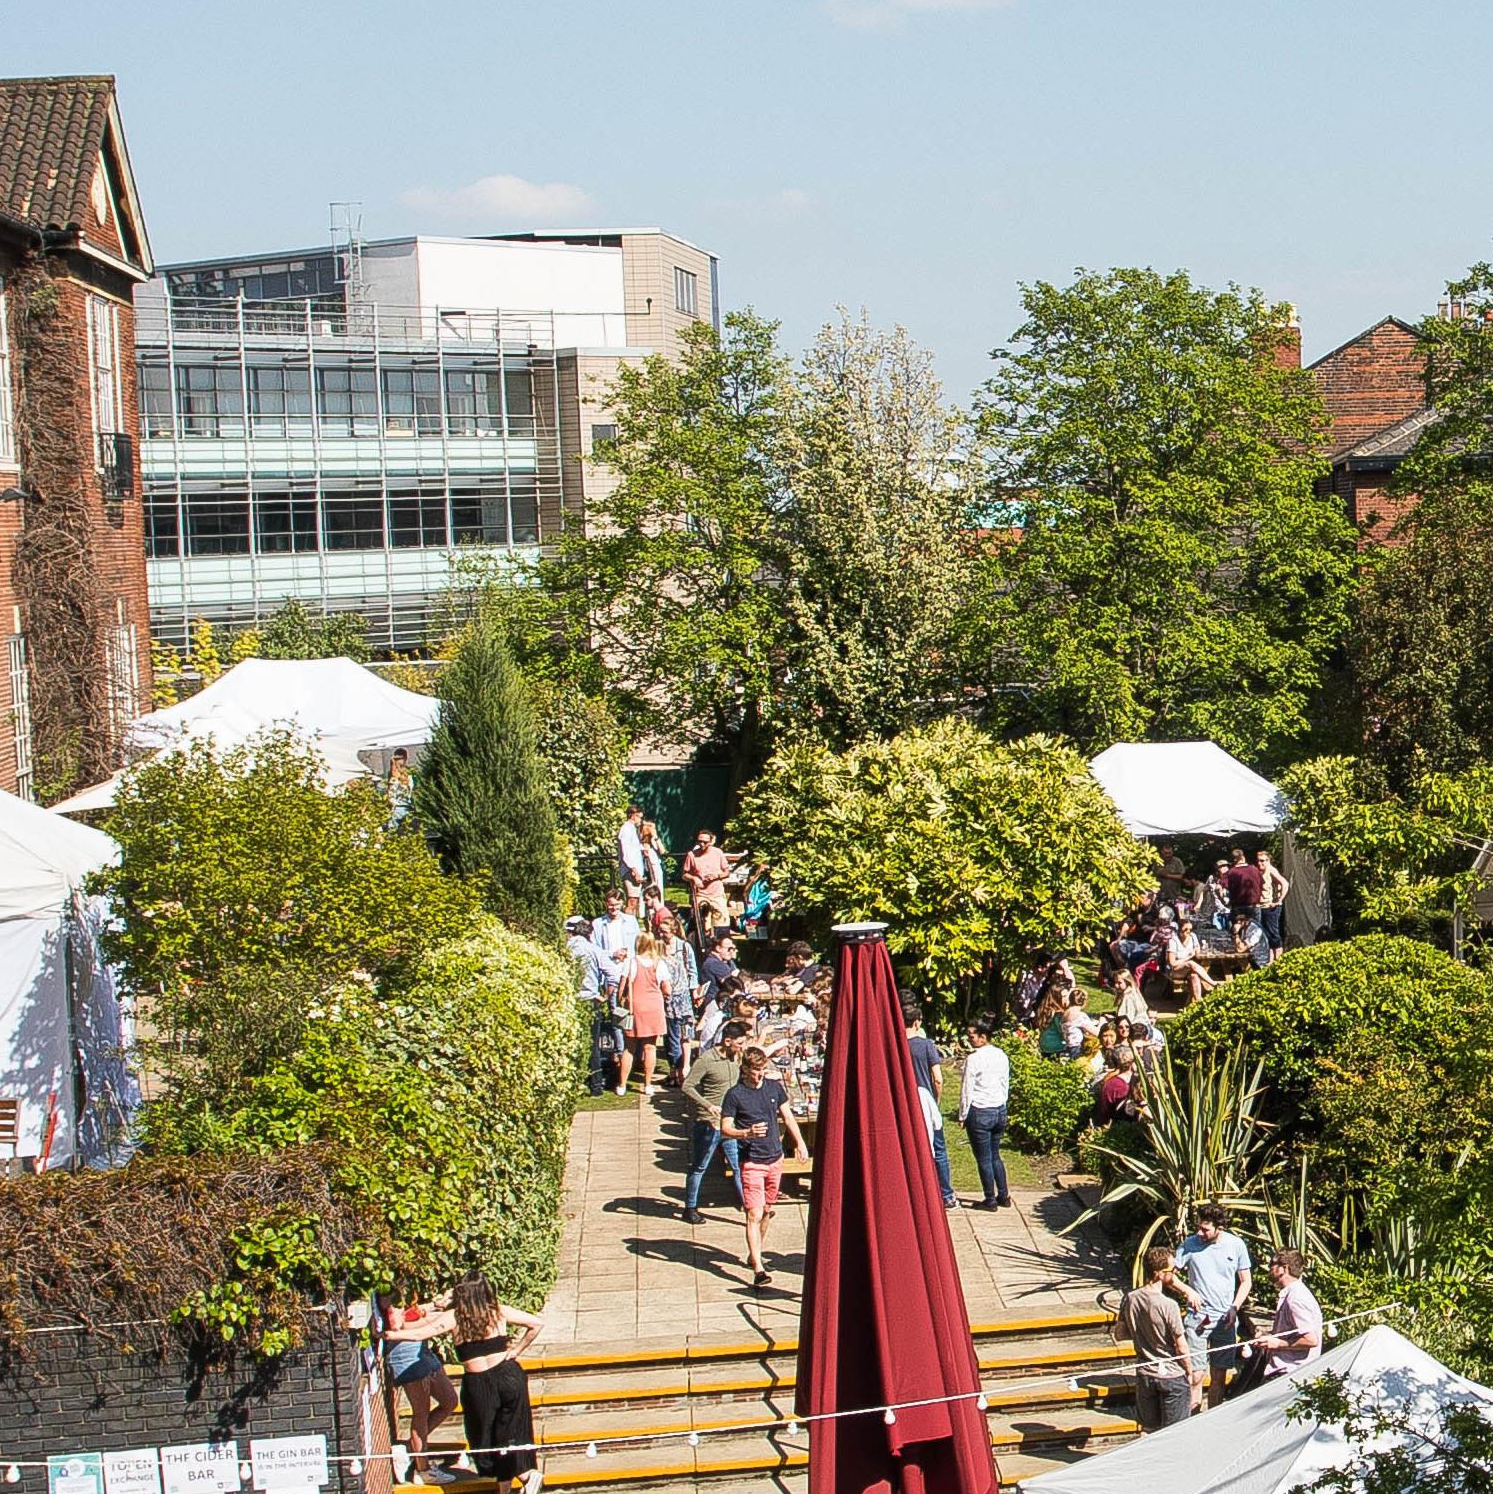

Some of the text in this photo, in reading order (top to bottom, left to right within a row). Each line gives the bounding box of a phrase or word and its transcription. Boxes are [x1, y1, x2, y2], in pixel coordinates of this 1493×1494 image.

[195, 1449, 234, 1462] CIDER
[256, 1447, 322, 1460] THE GIN BAR
[188, 1470, 215, 1481] BAR
